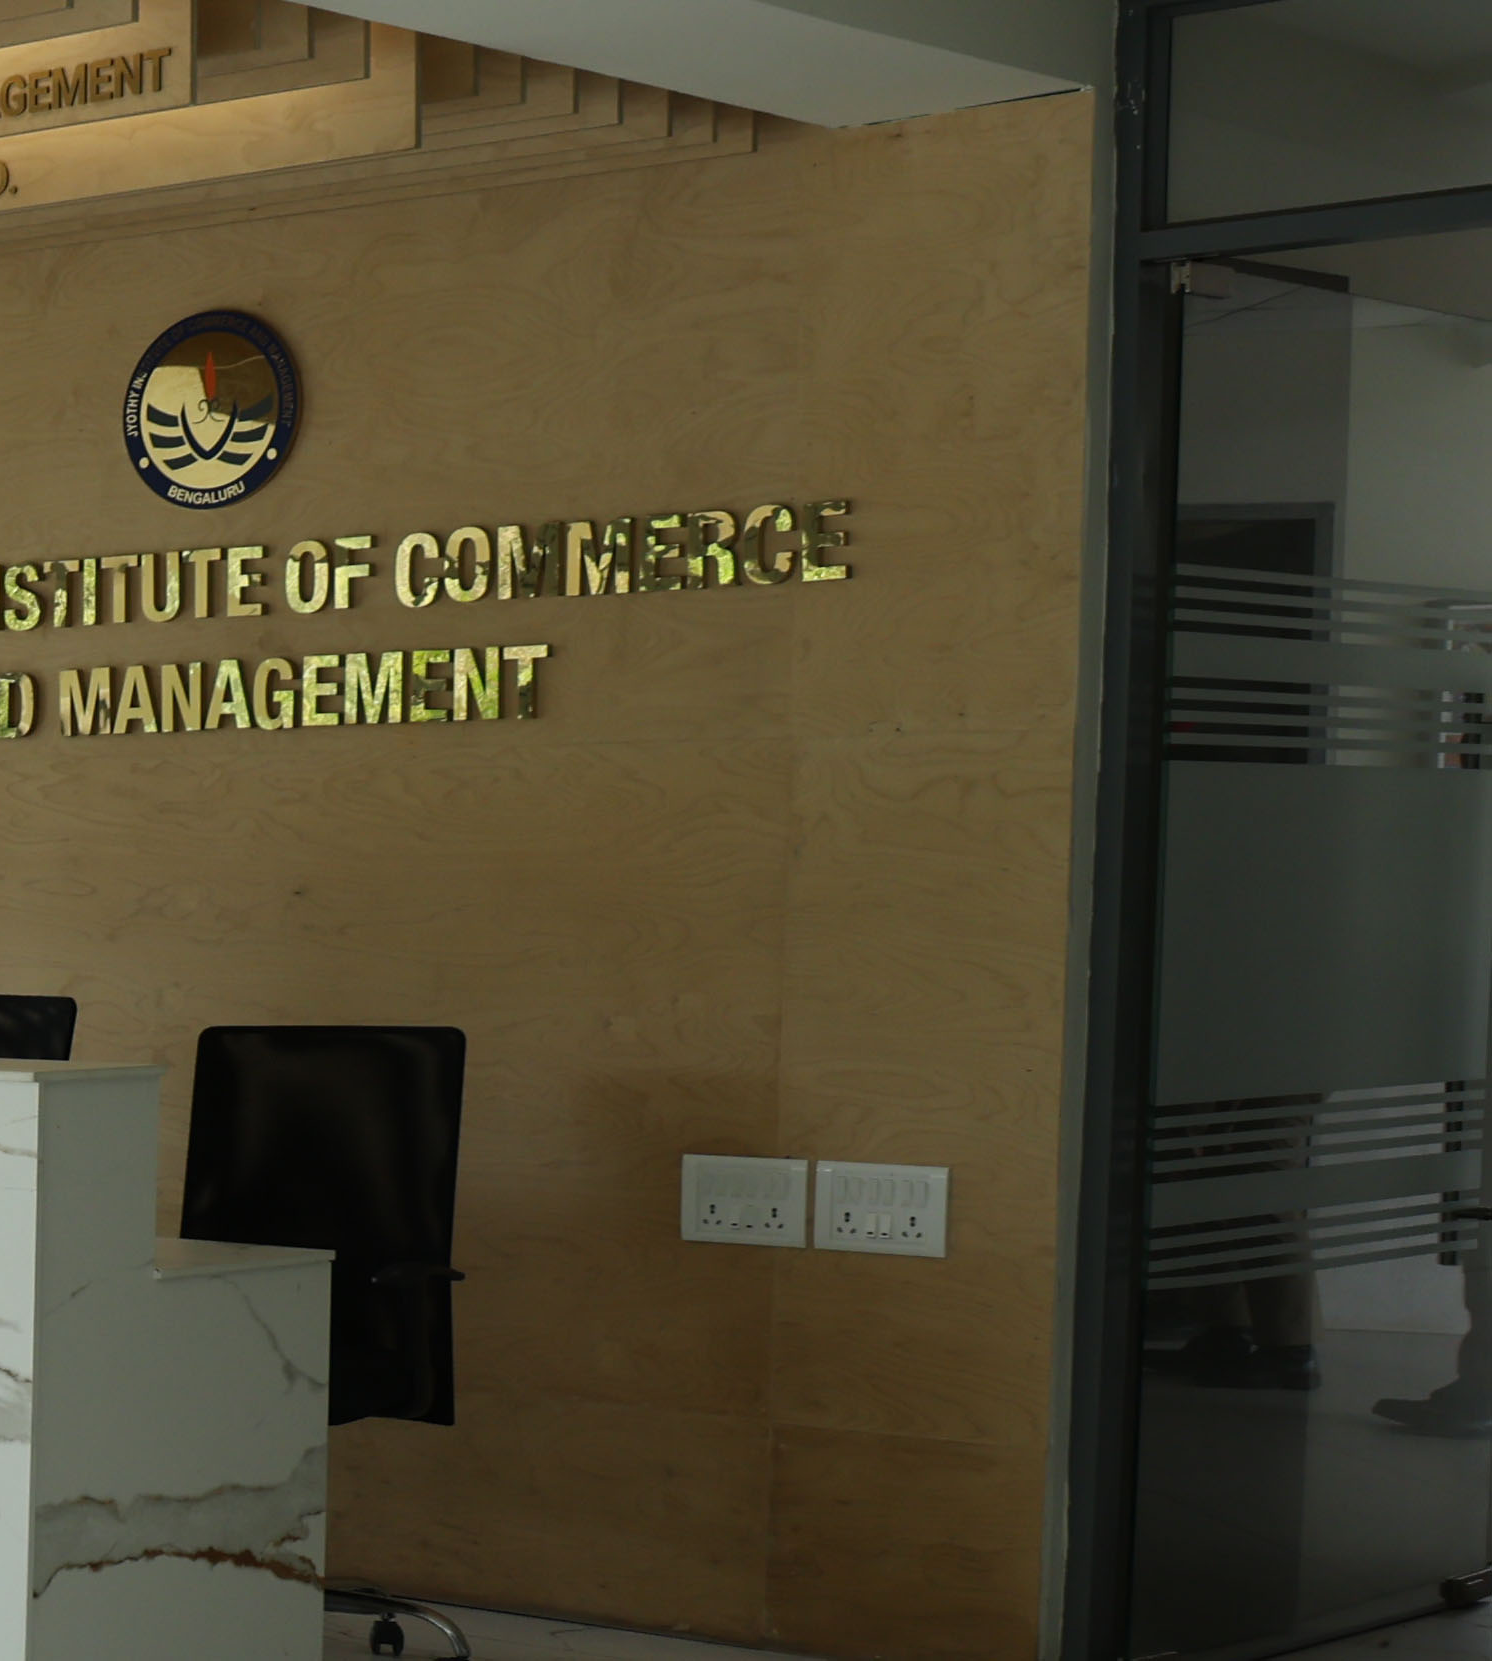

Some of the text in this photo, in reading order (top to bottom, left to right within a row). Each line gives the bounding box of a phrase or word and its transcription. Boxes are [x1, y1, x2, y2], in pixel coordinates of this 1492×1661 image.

[126, 388, 139, 438] JYOTHY
[167, 480, 246, 505] BENGALURU
[284, 535, 374, 614] OF
[394, 500, 851, 608] COMMERCE
[59, 643, 550, 737] MANAGEMENT
